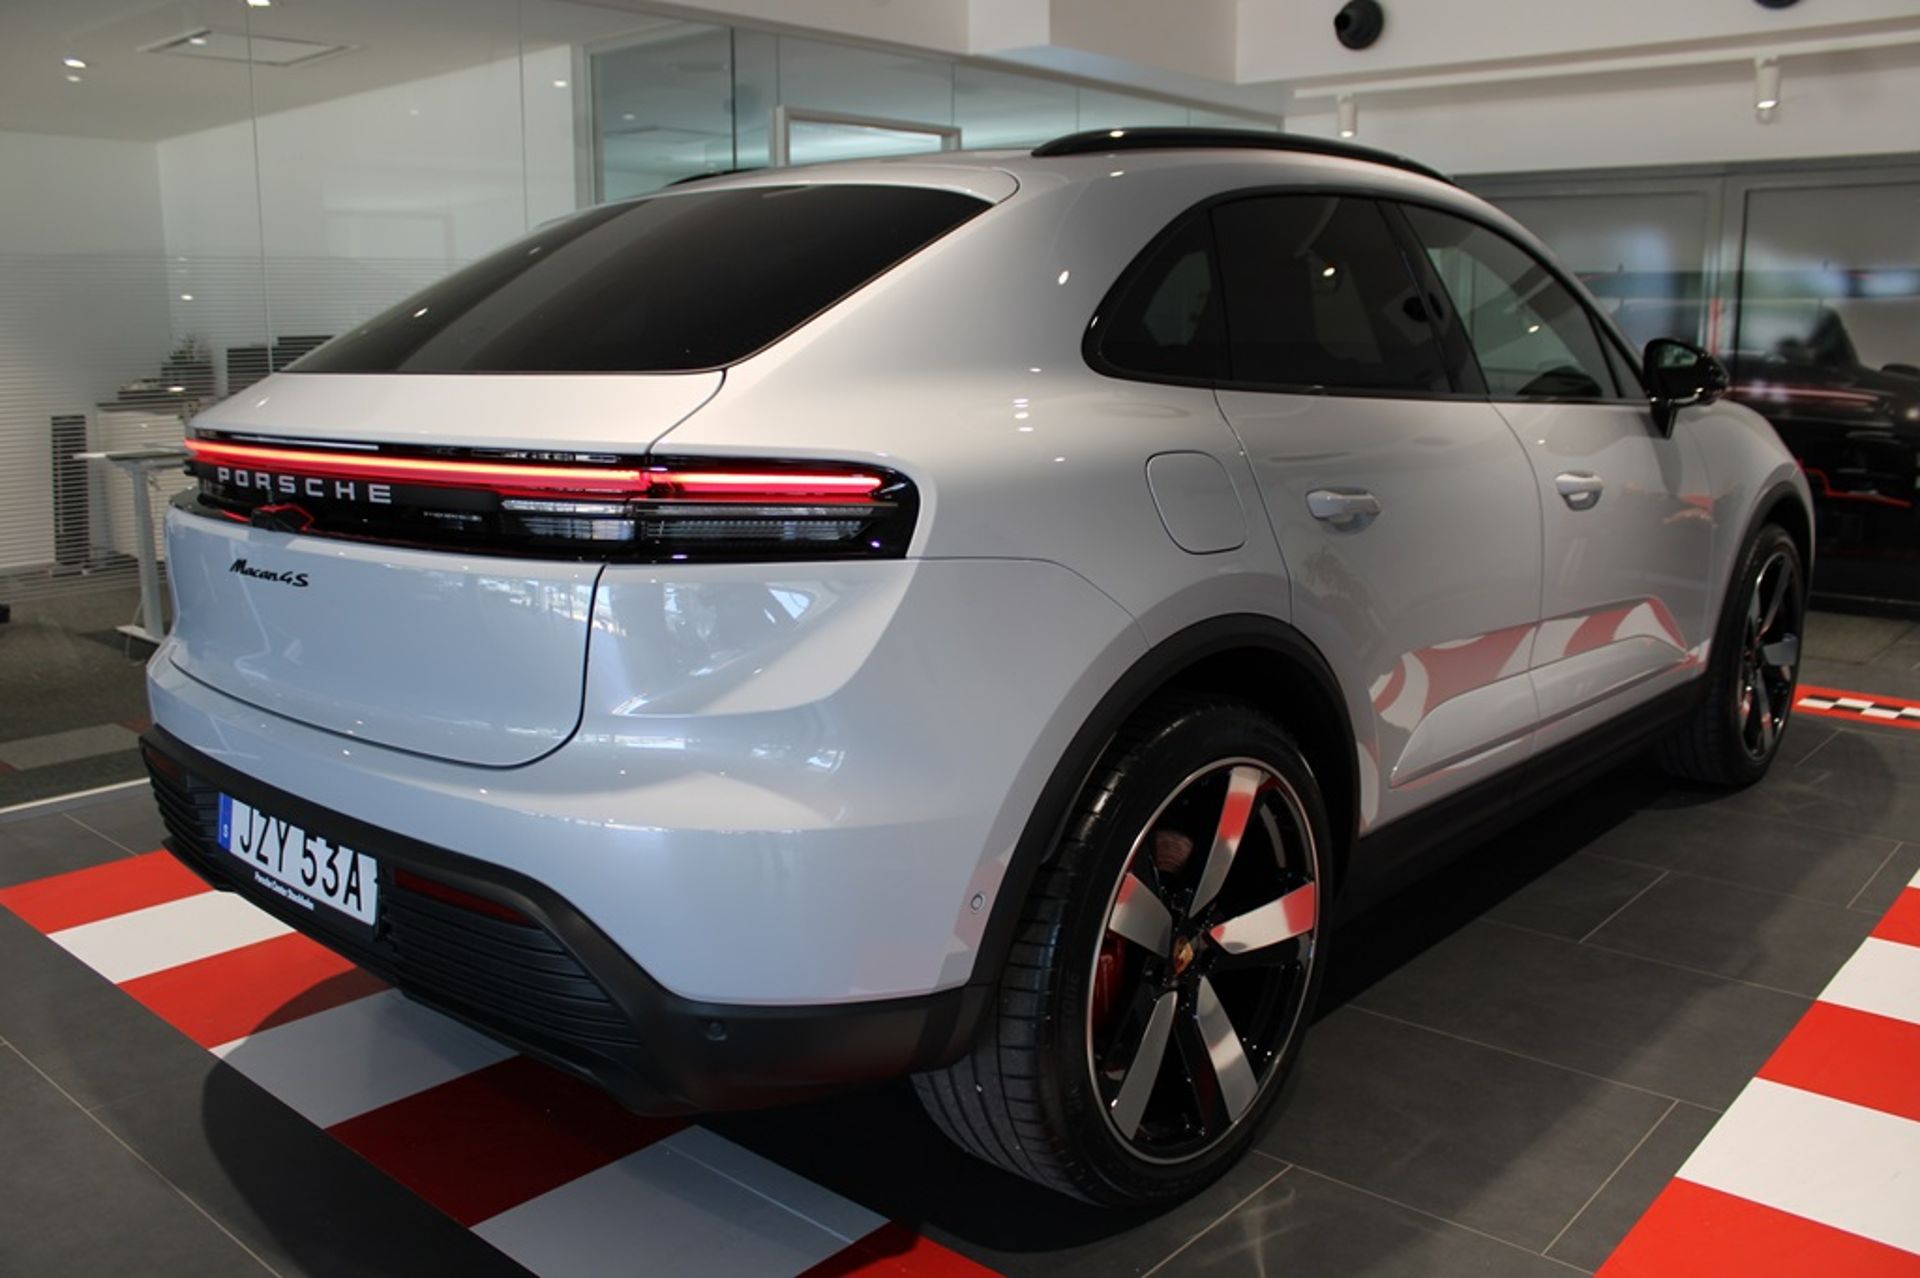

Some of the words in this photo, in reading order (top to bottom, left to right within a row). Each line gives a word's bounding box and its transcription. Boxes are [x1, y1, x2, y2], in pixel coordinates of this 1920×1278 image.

[218, 467, 392, 504] PORSCHE
[240, 812, 292, 873] JZY
[301, 837, 363, 911] 53A
